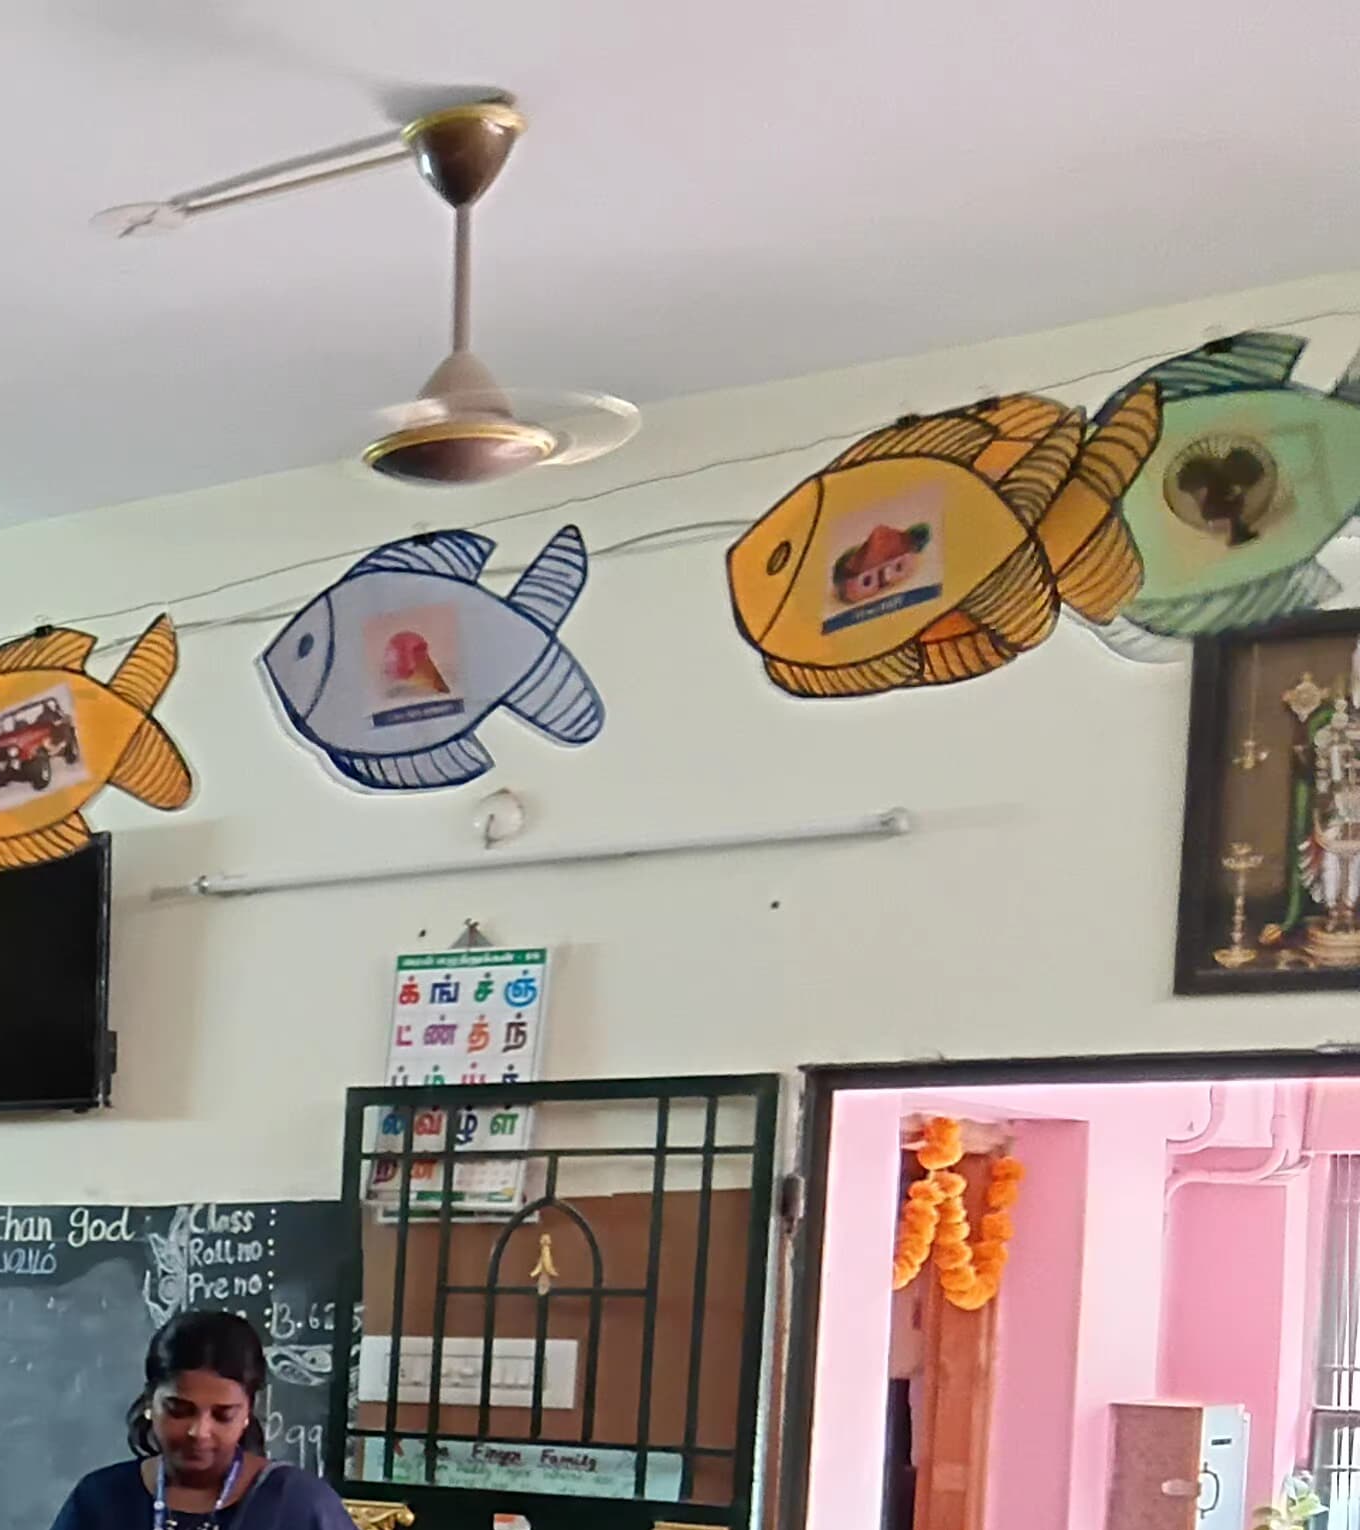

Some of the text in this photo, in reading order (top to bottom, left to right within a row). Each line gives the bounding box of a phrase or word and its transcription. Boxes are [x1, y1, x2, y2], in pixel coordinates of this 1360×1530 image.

[68, 1208, 136, 1247] god
[188, 1204, 255, 1234] Class
[188, 1273, 229, 1303] Pre
